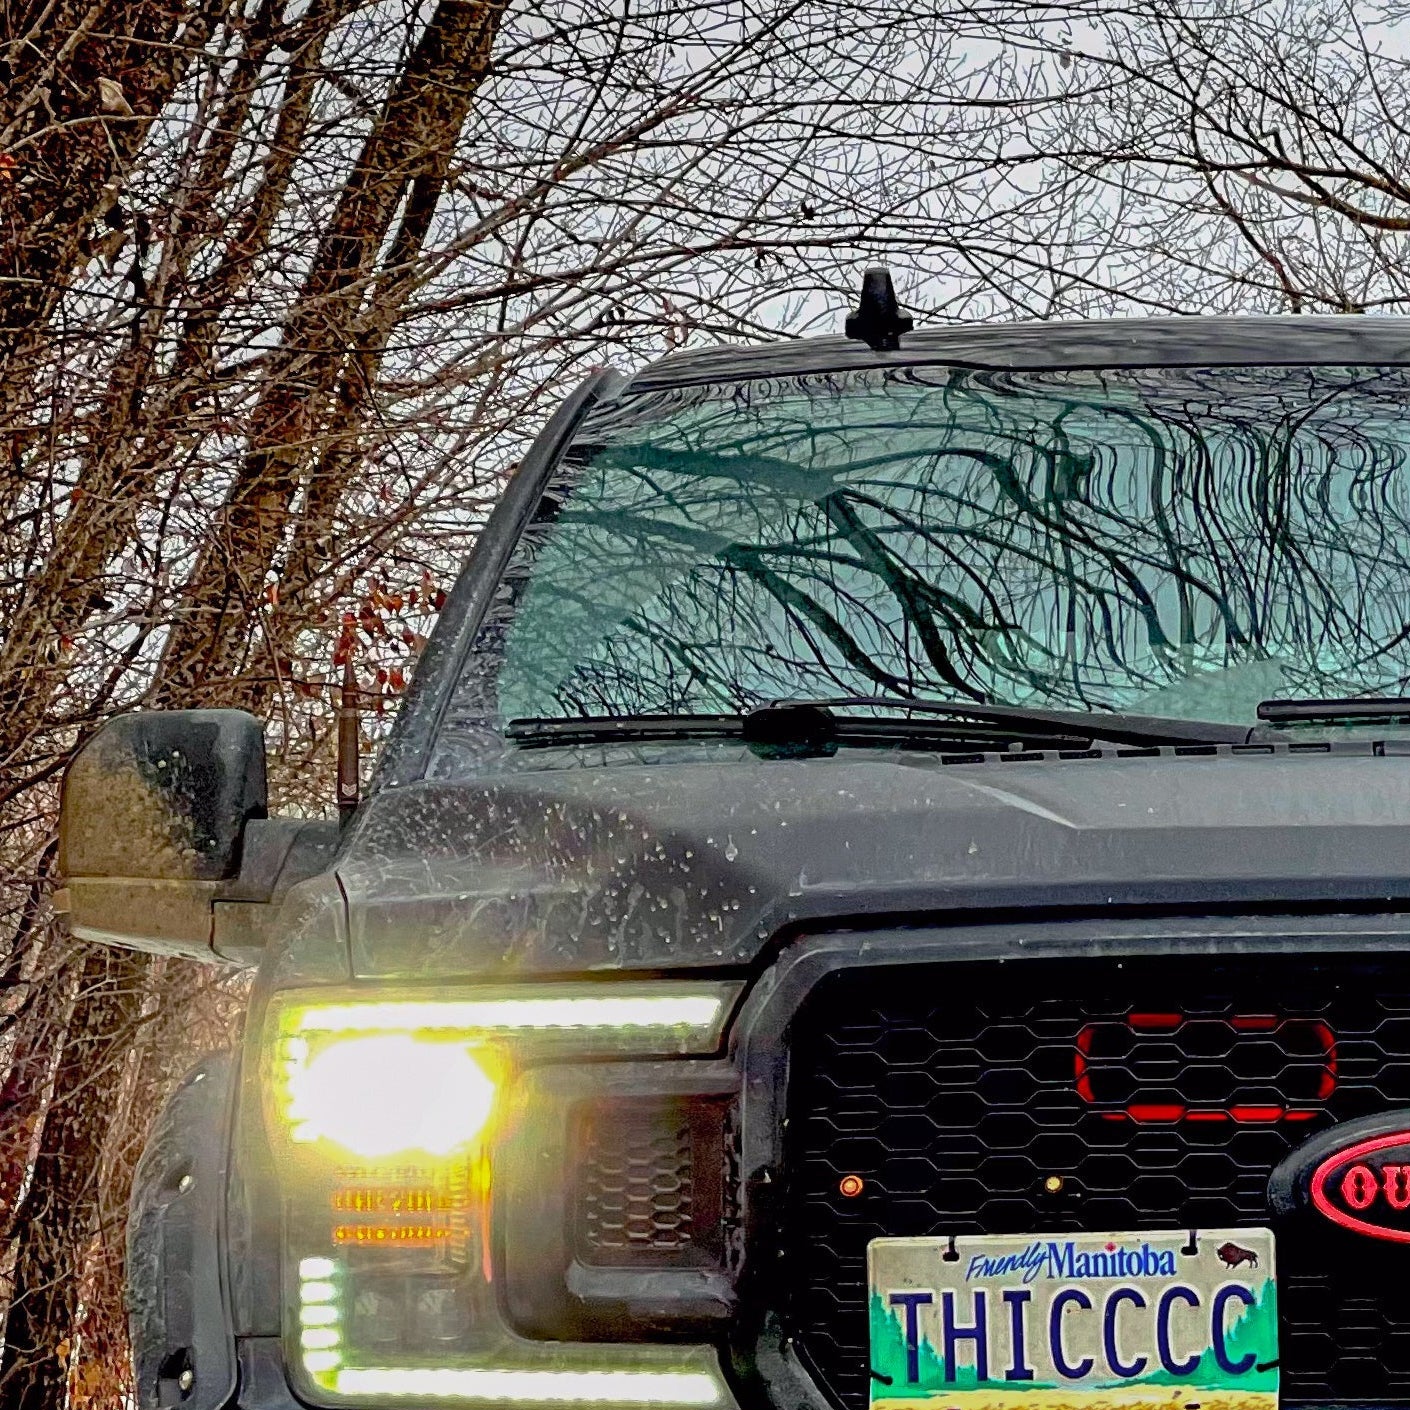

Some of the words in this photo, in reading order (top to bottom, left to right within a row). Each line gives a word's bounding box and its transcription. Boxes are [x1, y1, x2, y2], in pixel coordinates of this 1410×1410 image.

[966, 1241, 1049, 1284] Friendly
[1046, 1241, 1177, 1279] Manitoba
[889, 1283, 1258, 1384] THICCCC
